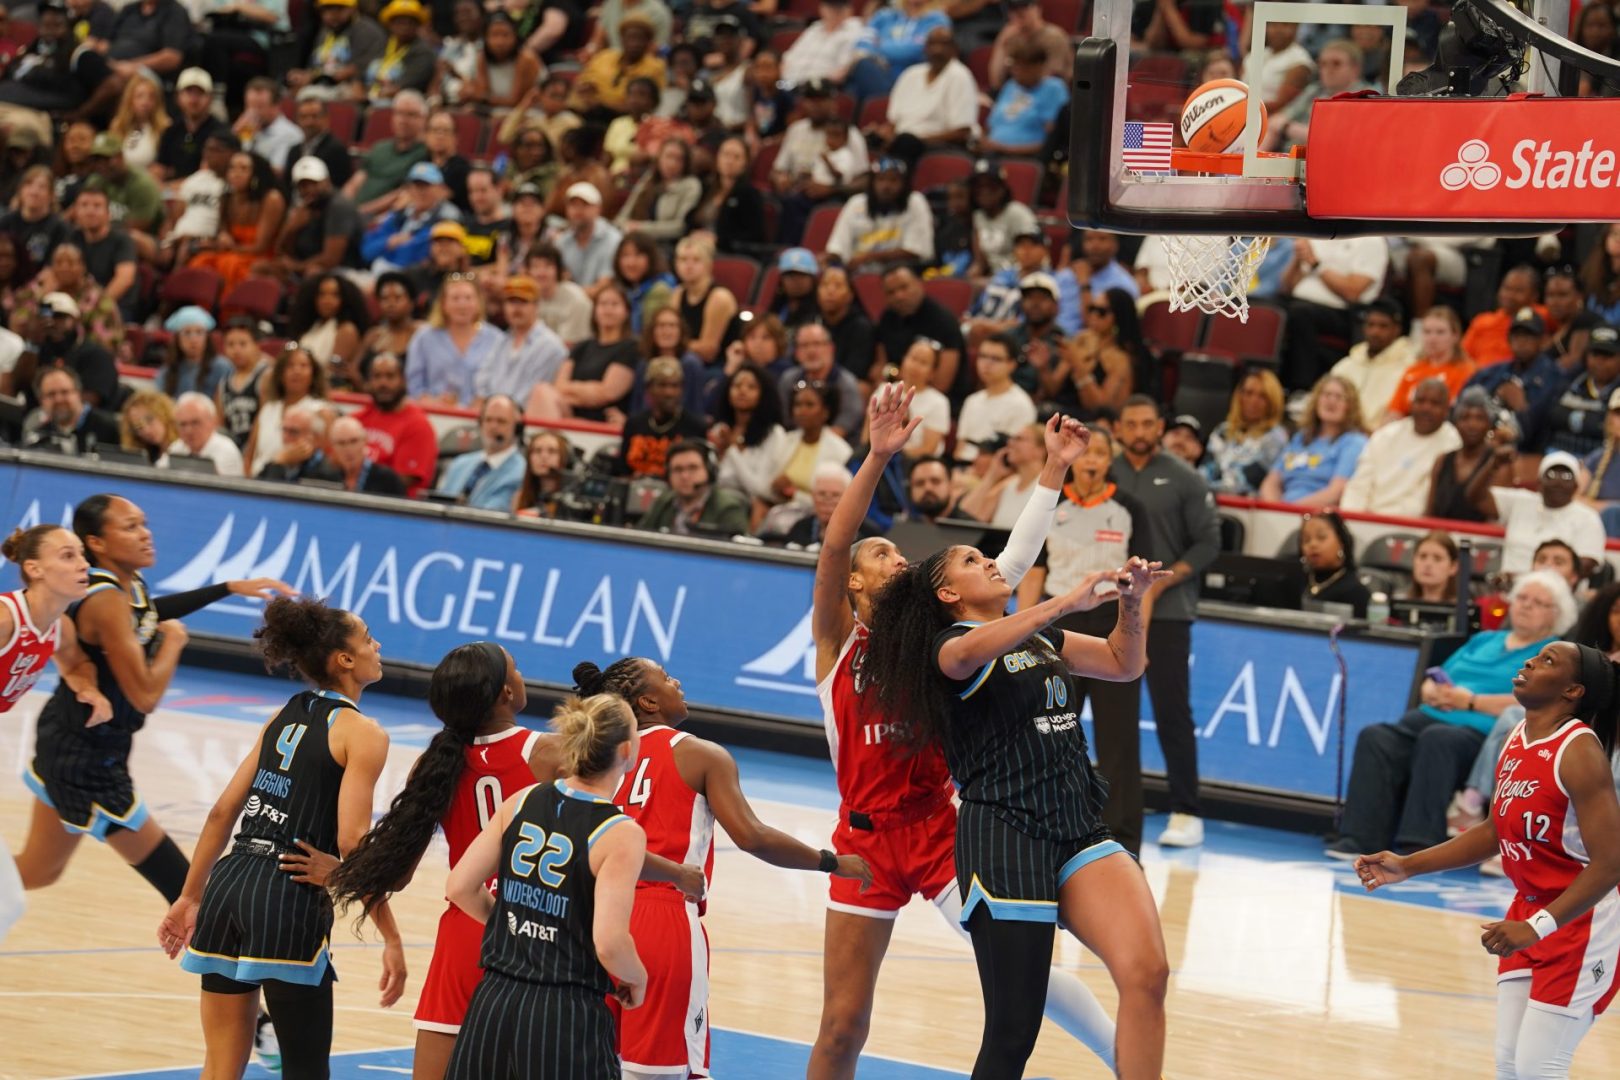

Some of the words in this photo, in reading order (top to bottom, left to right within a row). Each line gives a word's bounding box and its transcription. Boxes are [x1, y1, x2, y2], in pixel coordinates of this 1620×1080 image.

[1181, 94, 1224, 133] Wilson
[1505, 139, 1616, 190] State
[294, 536, 687, 662] MAGELLAN
[1044, 675, 1068, 710] 10
[276, 722, 308, 772] 4
[1499, 754, 1519, 778] Las
[1537, 748, 1553, 762] ally
[475, 775, 503, 832] 0
[1494, 765, 1541, 817] Vegas
[1522, 810, 1550, 843] 12
[511, 821, 574, 889] 22
[518, 919, 559, 942] AT&T
